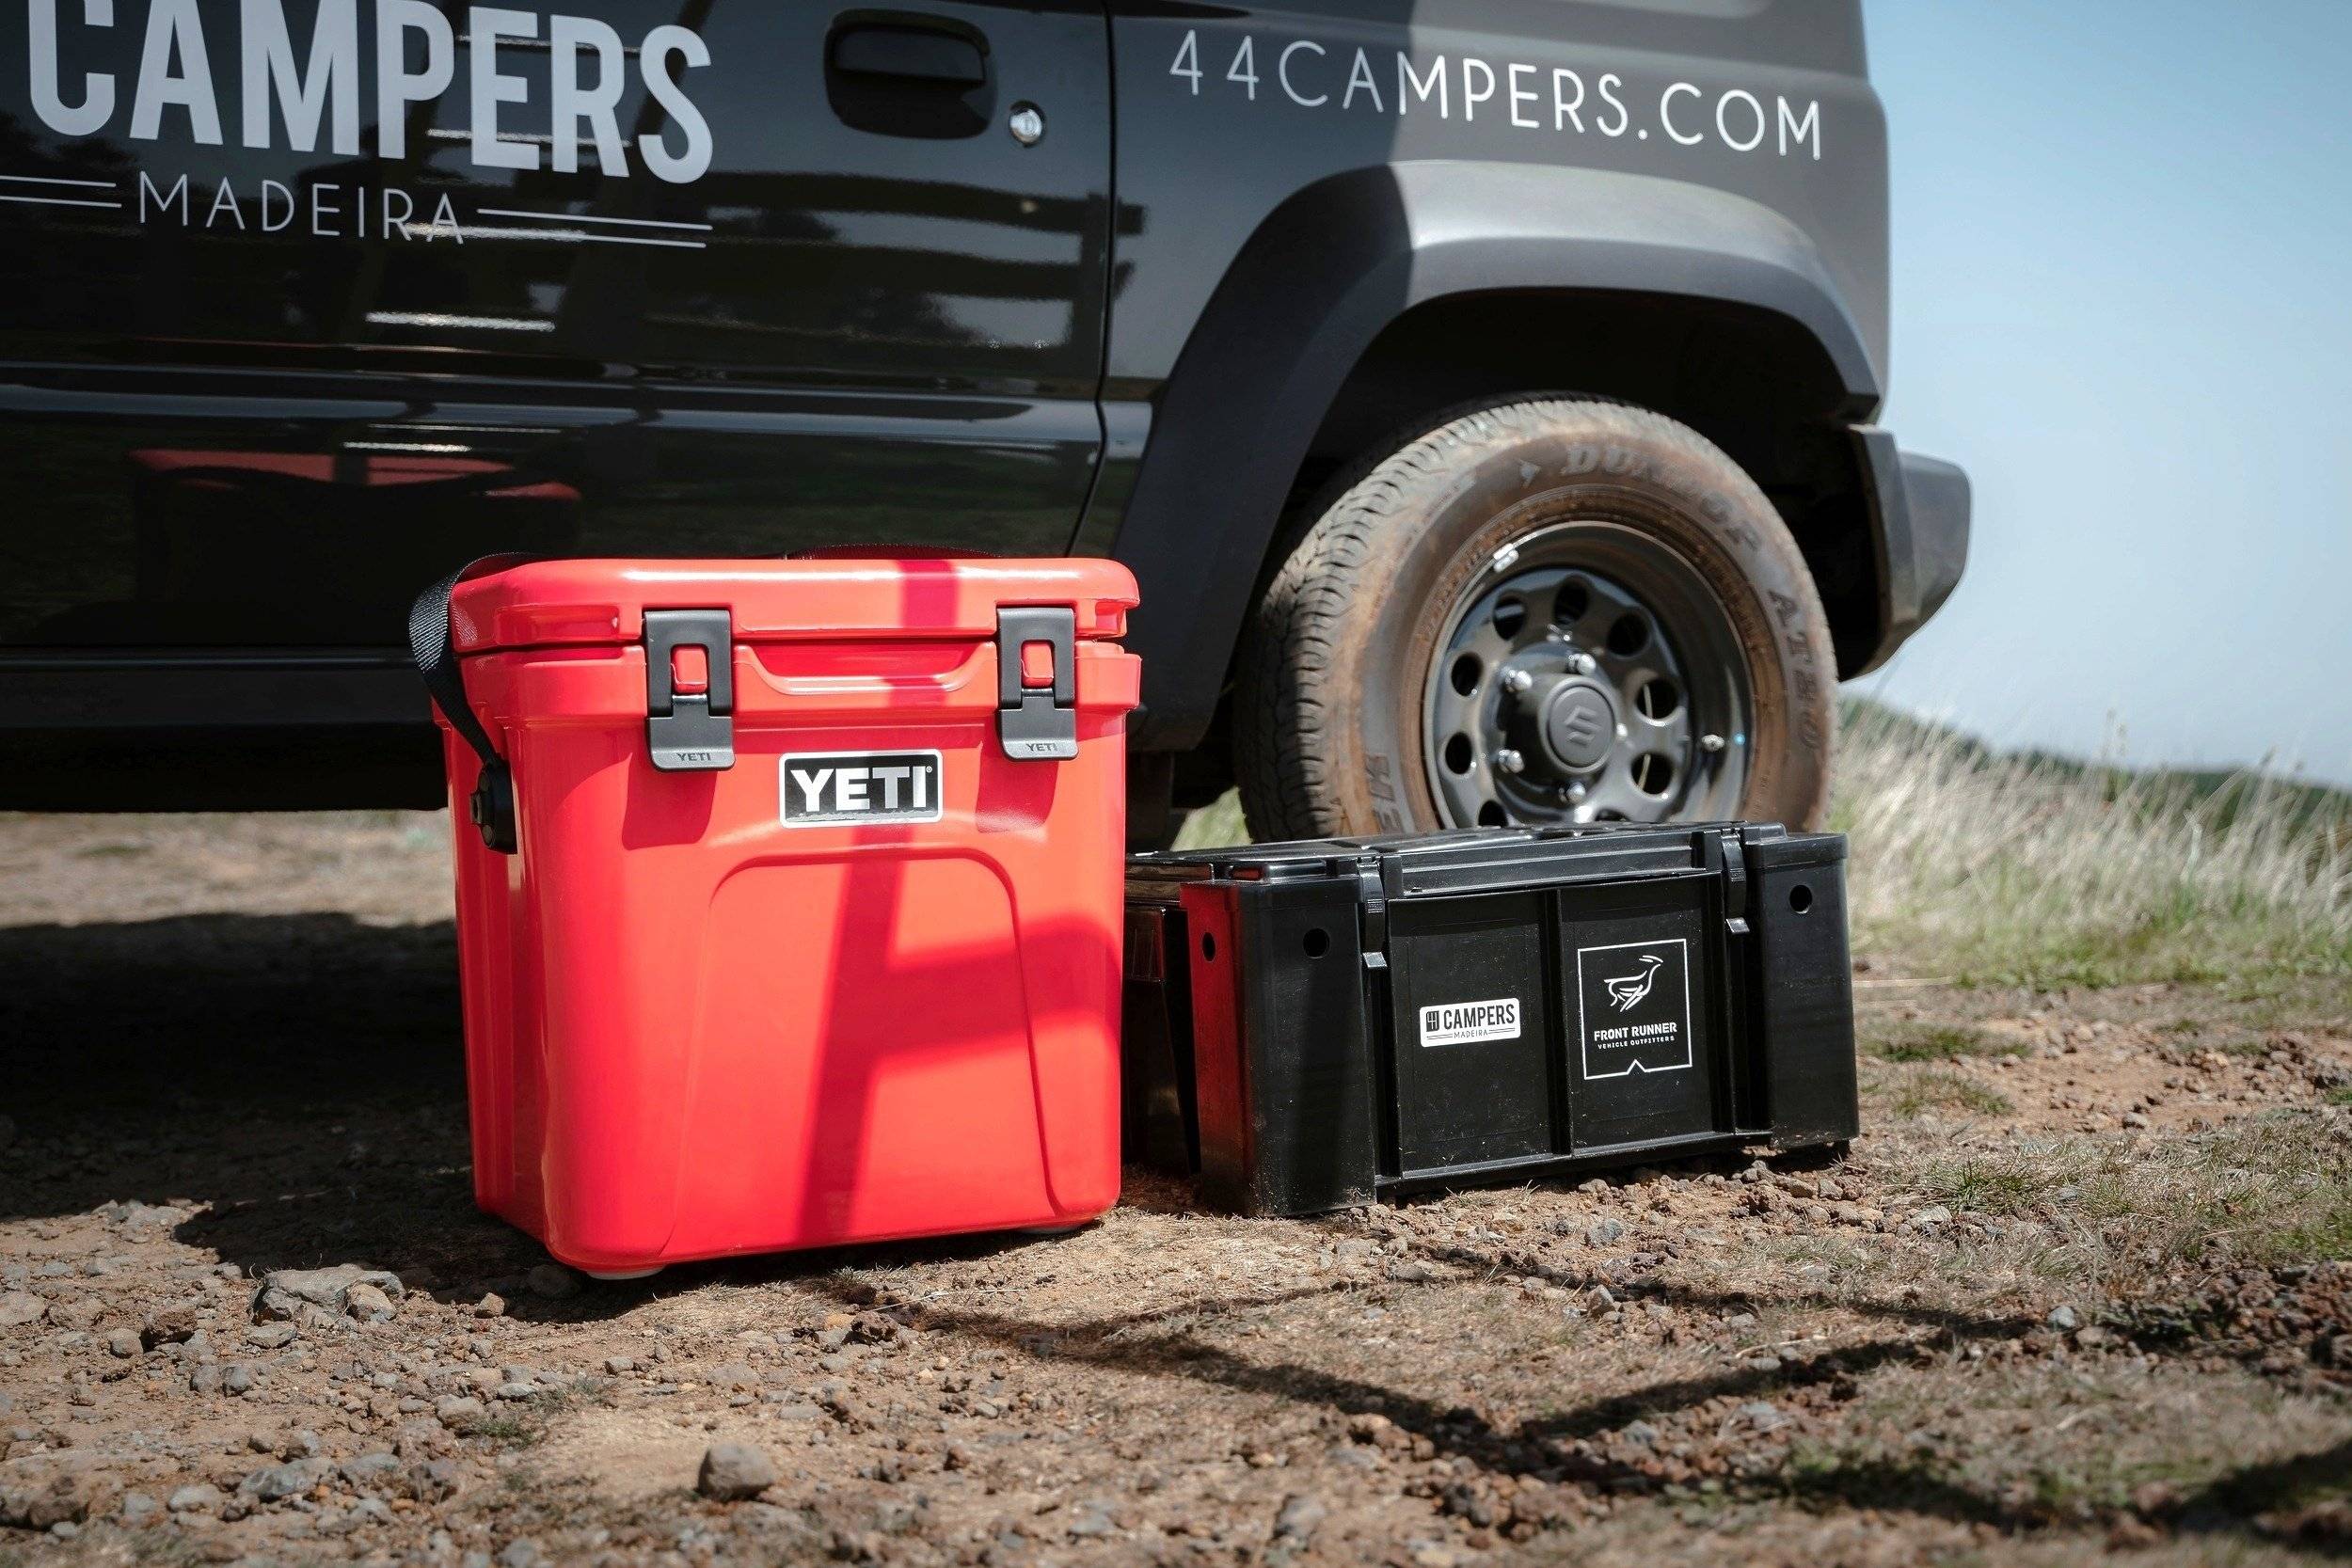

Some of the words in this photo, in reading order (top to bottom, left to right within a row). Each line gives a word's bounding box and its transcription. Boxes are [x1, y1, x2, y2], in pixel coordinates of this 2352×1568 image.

[28, 0, 714, 184] CAMPERS
[1168, 28, 1821, 161] 44CAMPERS.COM
[138, 170, 465, 245] MADEIRA
[1025, 742, 1058, 752] YETI
[676, 752, 711, 762] YETI
[1443, 1004, 1516, 1030] CAMPERS
[1454, 1029, 1488, 1039] MADEIRA
[1594, 1026, 1629, 1041] FRONT
[1631, 1022, 1677, 1037] RUNNER
[1597, 1040, 1629, 1050] VEHICLE
[1629, 1035, 1676, 1046] OUTFITTERS
